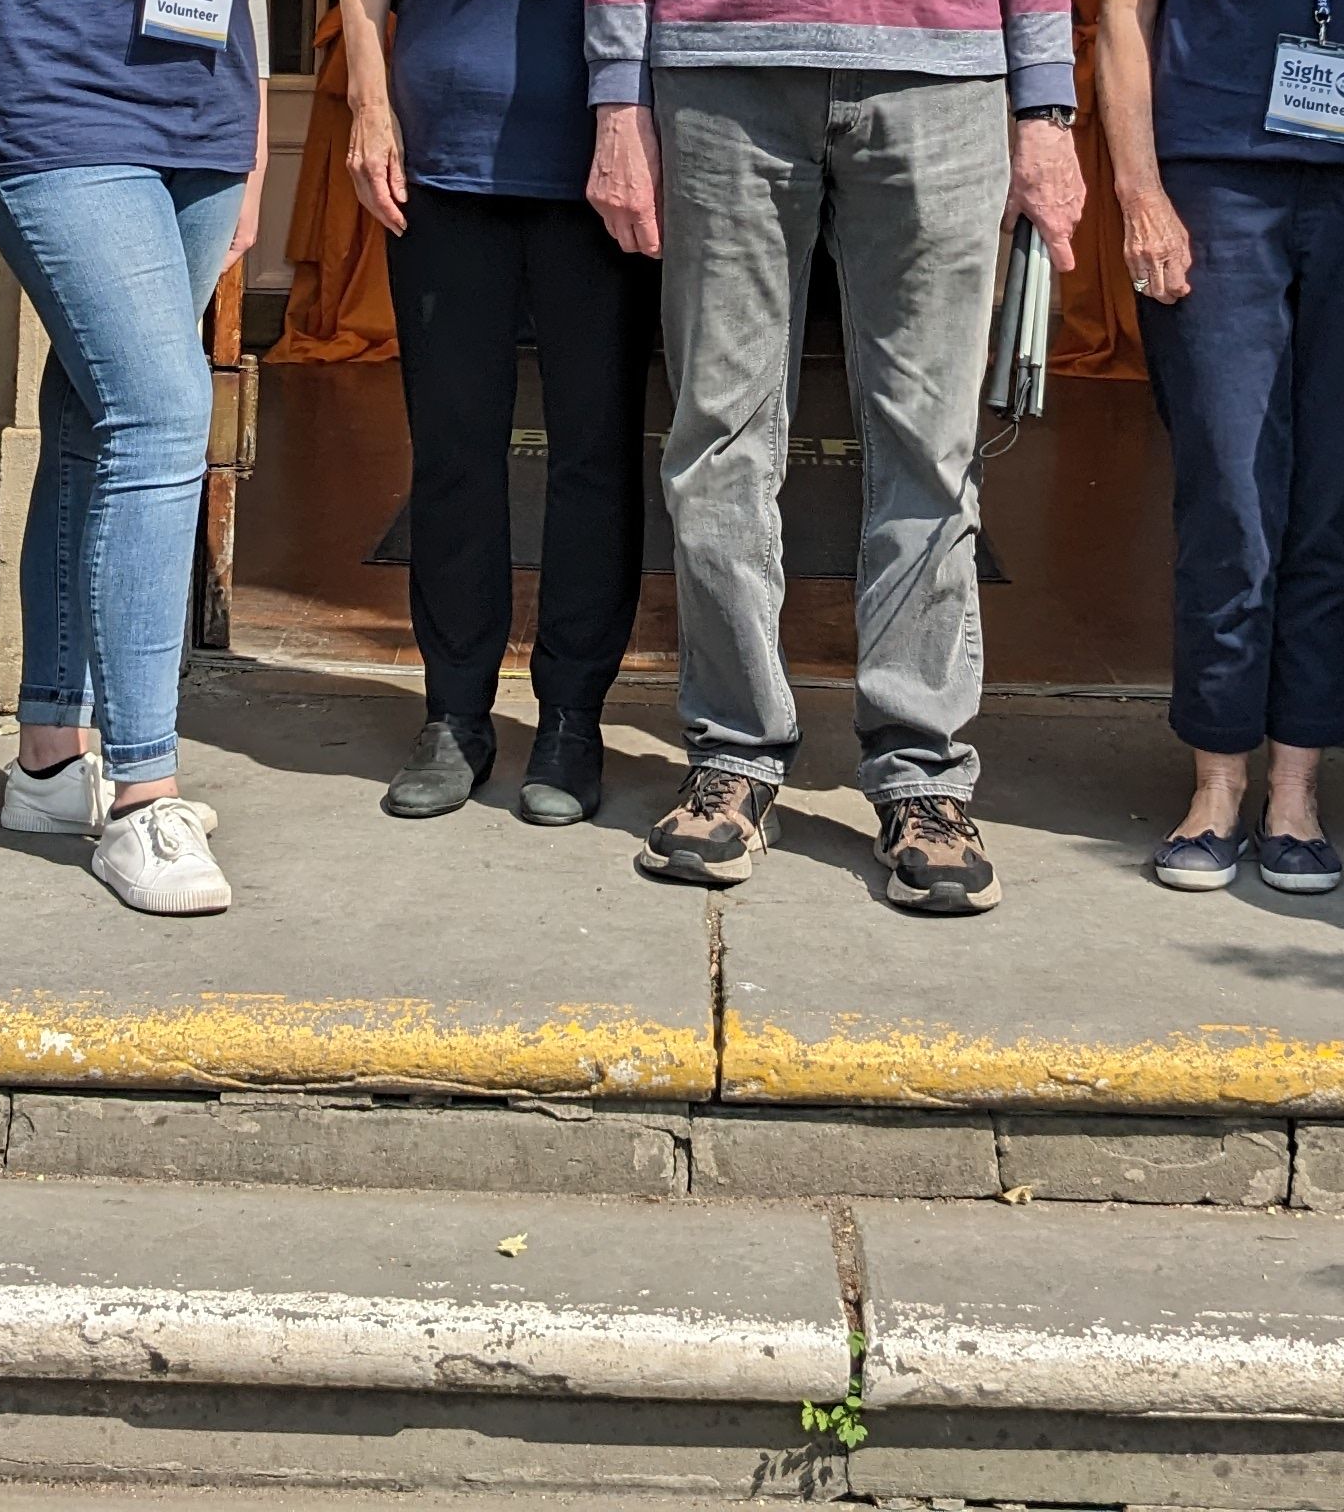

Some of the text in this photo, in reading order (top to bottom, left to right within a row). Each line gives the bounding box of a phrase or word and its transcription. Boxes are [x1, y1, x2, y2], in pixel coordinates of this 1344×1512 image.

[157, 0, 219, 23] Volunteer
[1281, 60, 1333, 85] Sight
[1279, 80, 1332, 95] SUPPORT
